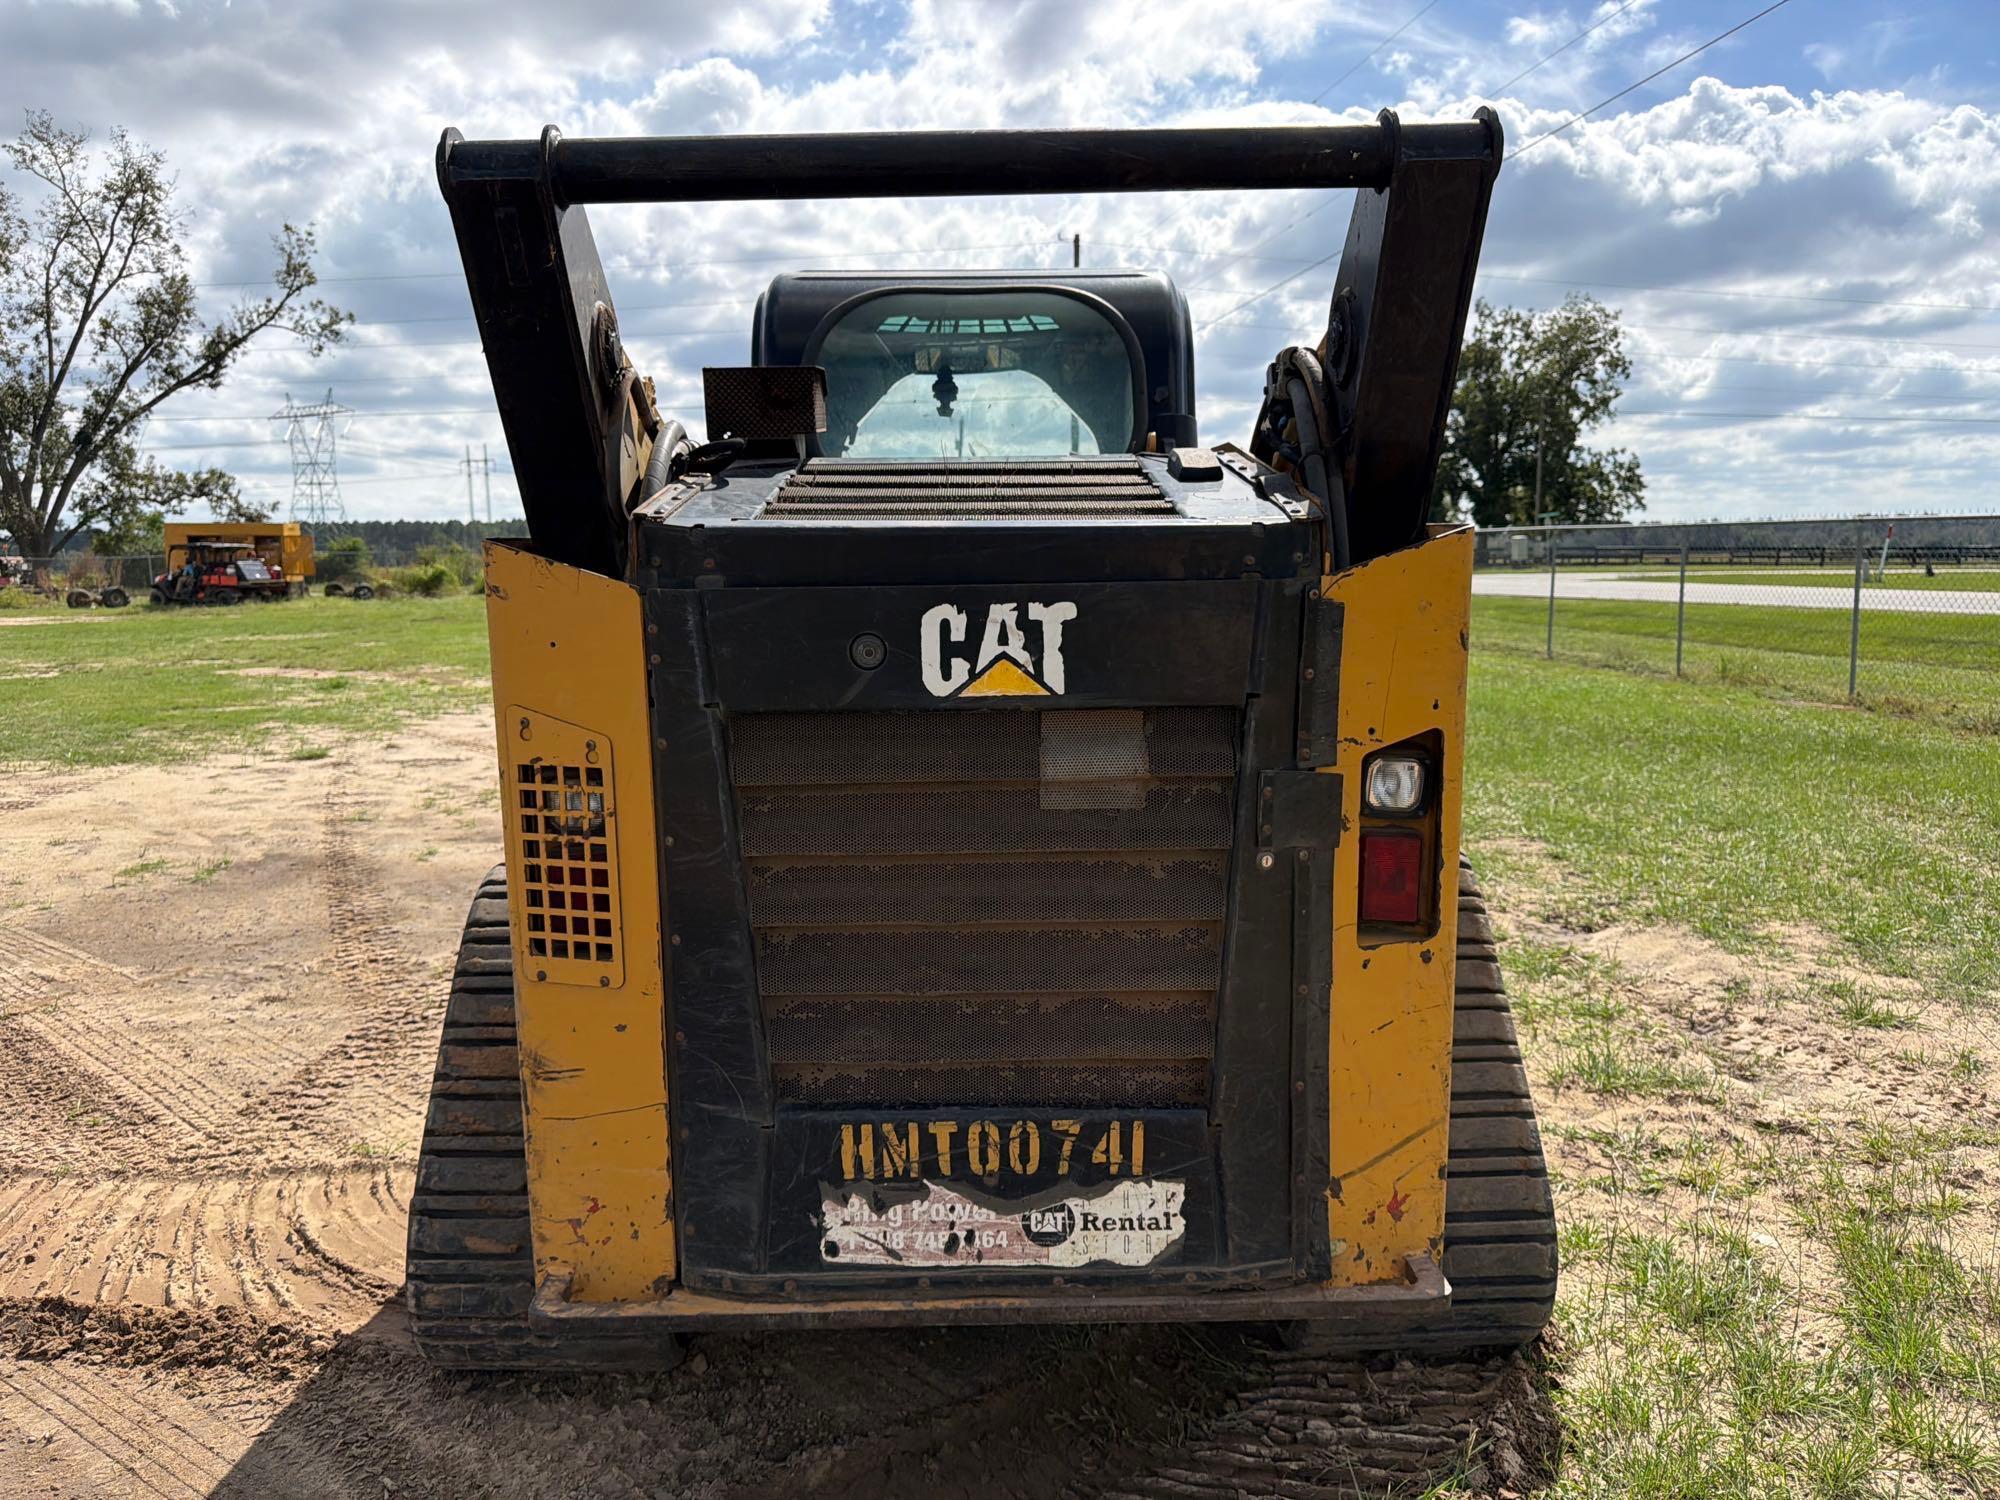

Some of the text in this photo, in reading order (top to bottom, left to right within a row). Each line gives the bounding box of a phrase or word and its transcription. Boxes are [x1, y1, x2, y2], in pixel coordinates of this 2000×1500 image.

[921, 601, 1077, 697] CAT
[1030, 1212, 1066, 1232] CAT
[1080, 1212, 1172, 1232] Rental
